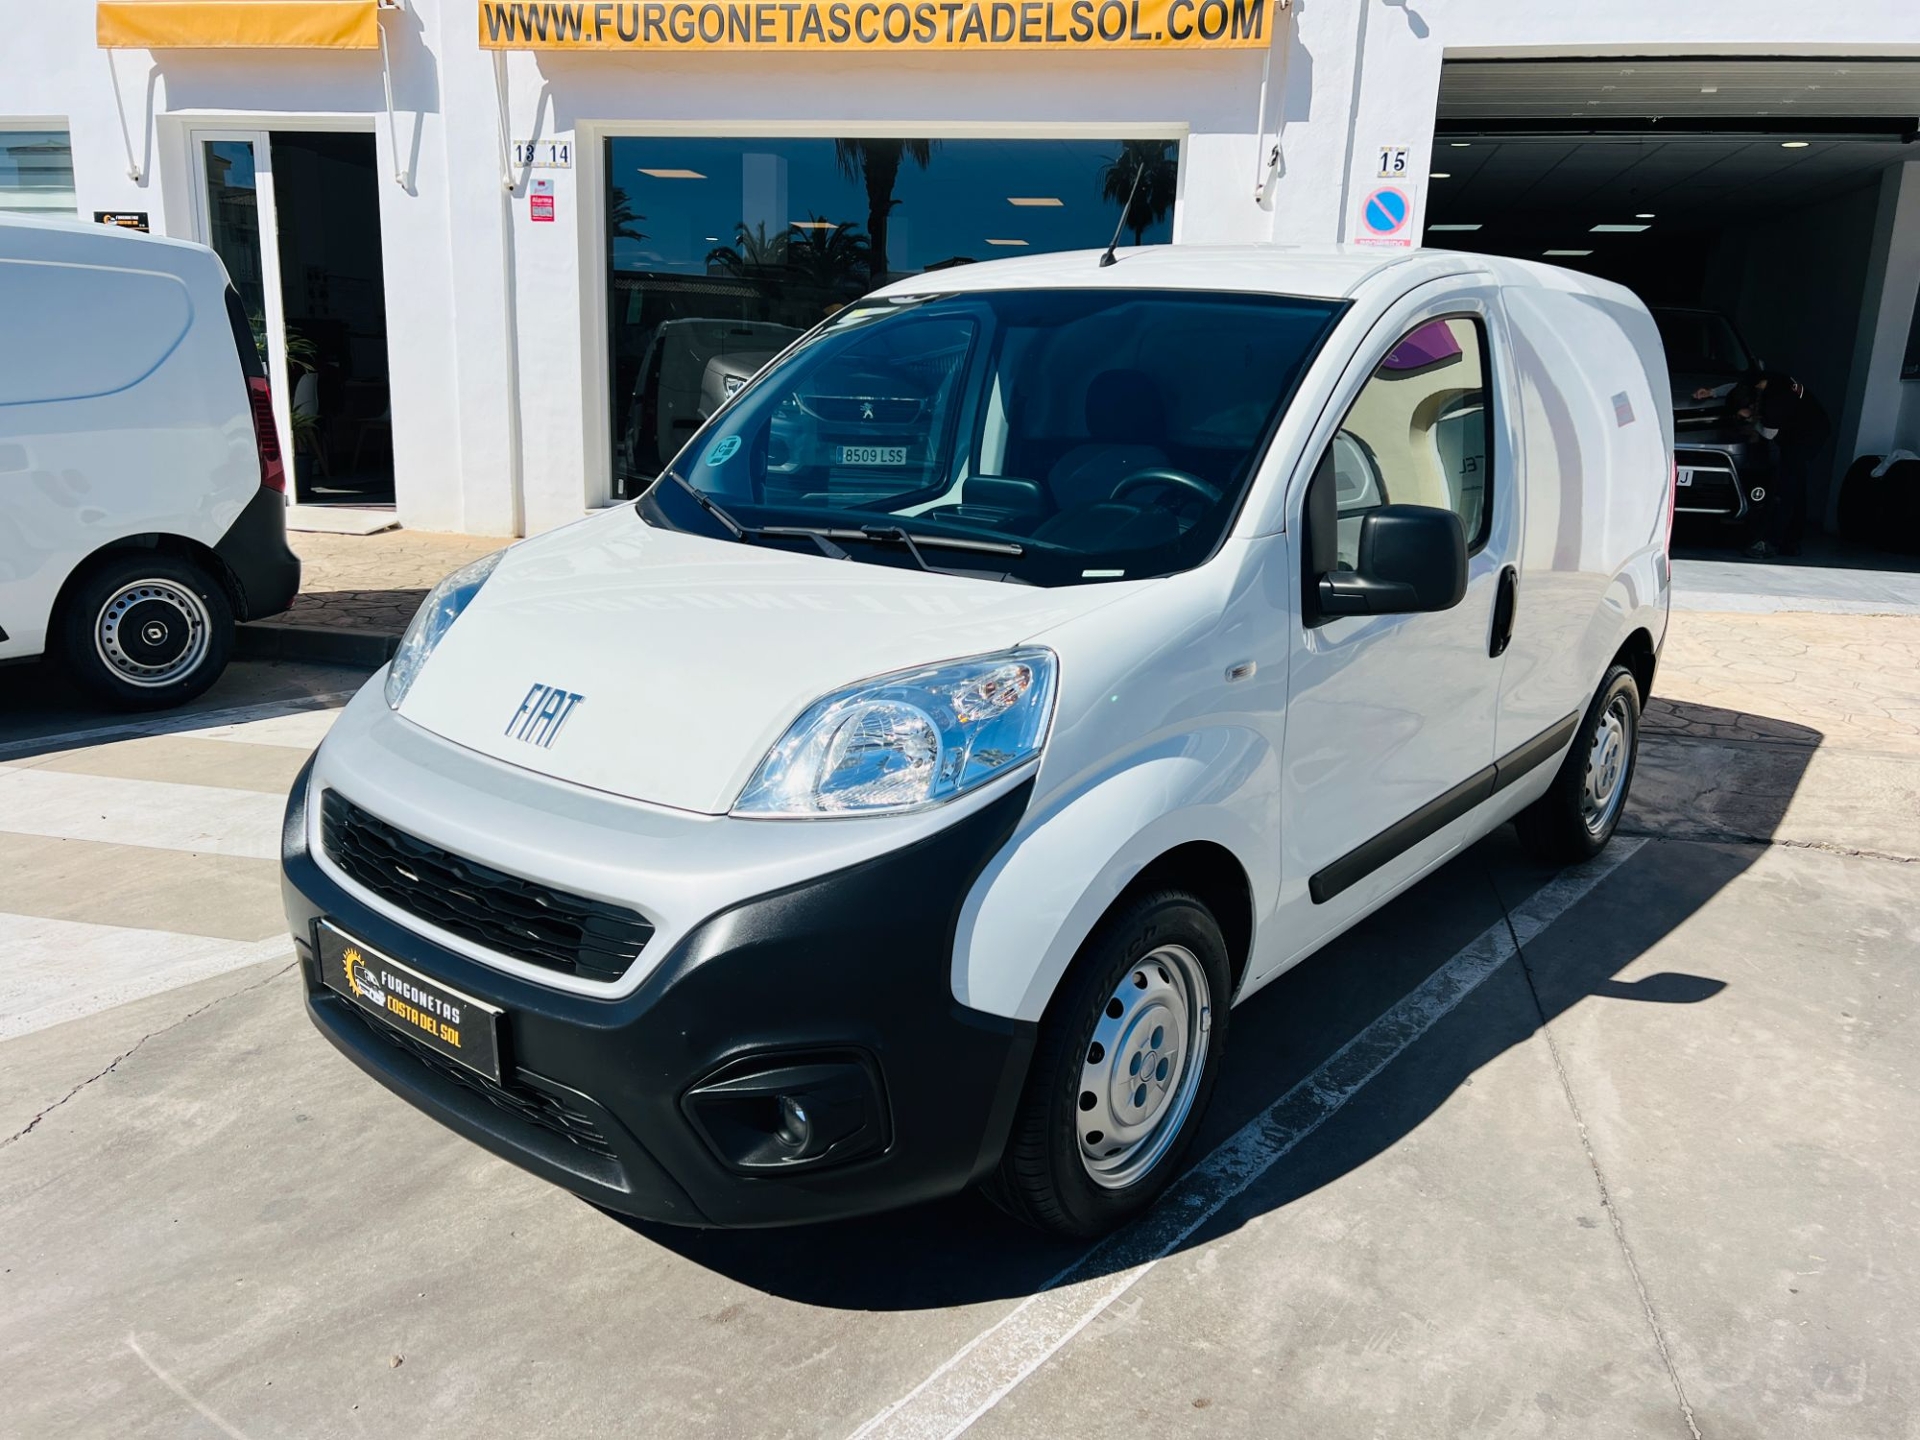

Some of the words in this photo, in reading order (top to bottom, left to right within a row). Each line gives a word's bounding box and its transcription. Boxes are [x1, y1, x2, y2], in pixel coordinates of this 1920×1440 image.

[484, 0, 1263, 42] WWW.FURGONETASCOSTADELSOL.COM
[515, 144, 534, 162] 13
[550, 144, 568, 163] 14
[1380, 151, 1405, 172] 15
[845, 448, 877, 463] 8509
[880, 449, 903, 463] LSS
[504, 682, 586, 750] FIAT
[381, 970, 460, 1024] FURGONETAS
[387, 995, 419, 1026] COSTA
[420, 1014, 439, 1037] DEL
[440, 1024, 462, 1048] SOL
